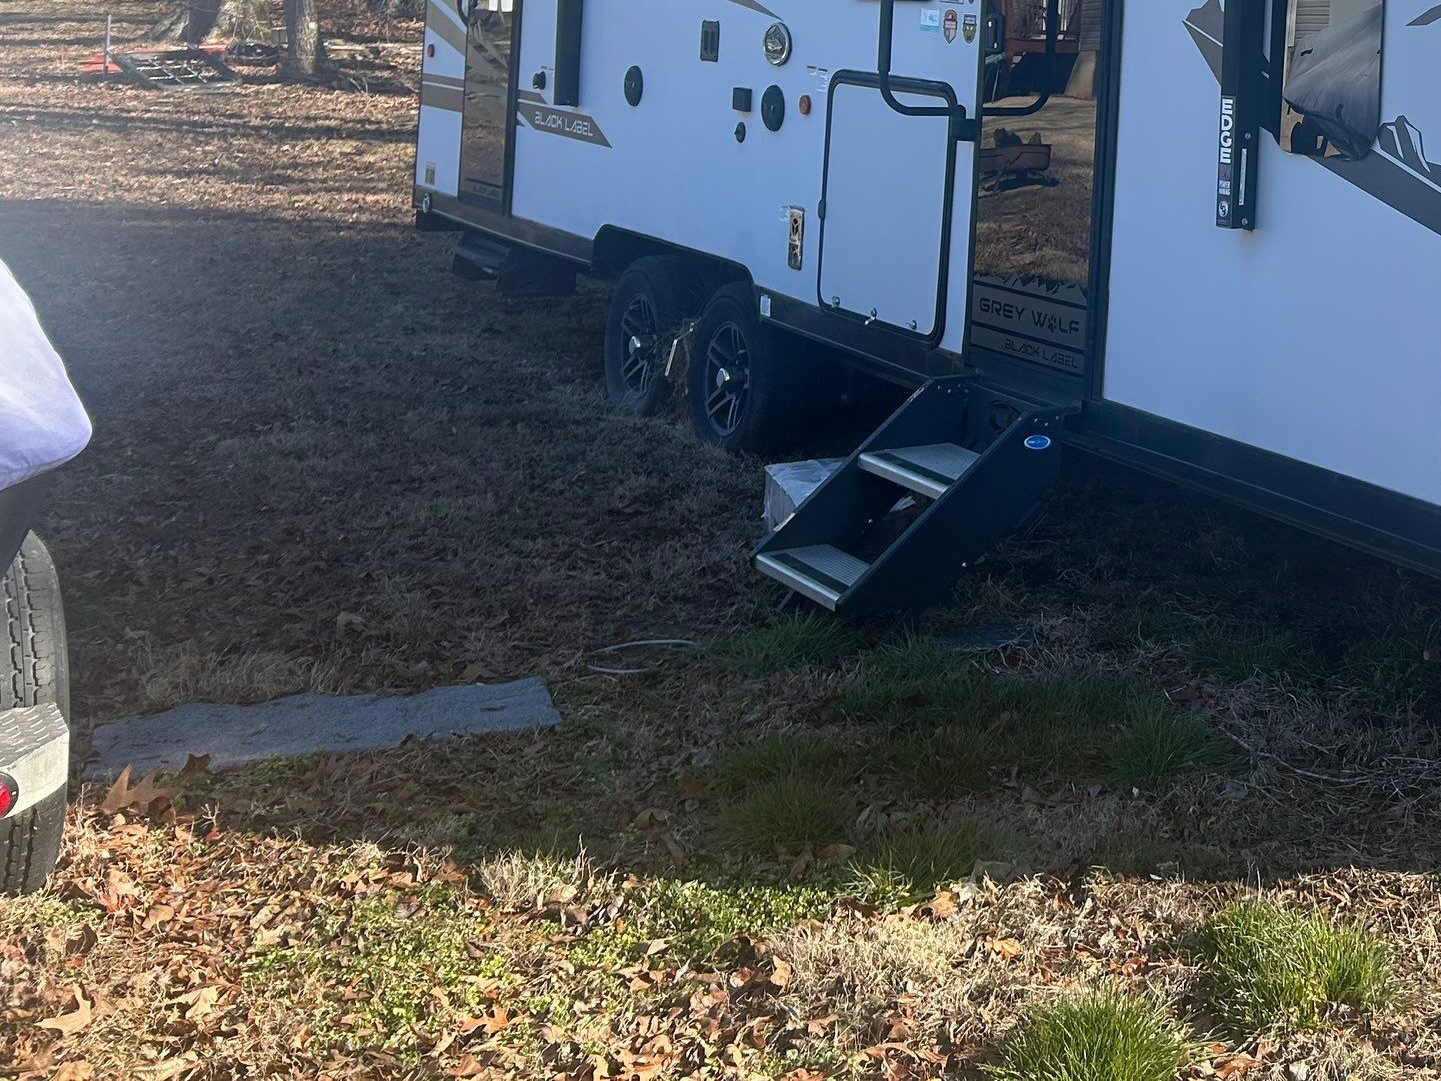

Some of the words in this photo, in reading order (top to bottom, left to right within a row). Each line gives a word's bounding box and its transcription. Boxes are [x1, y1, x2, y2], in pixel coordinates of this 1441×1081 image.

[534, 111, 563, 129] BLACK
[564, 117, 594, 137] LABEL
[1220, 98, 1234, 164] EDGE
[980, 297, 1026, 322] GREY
[1004, 339, 1040, 357] BLACK
[1042, 351, 1079, 369] LABEL
